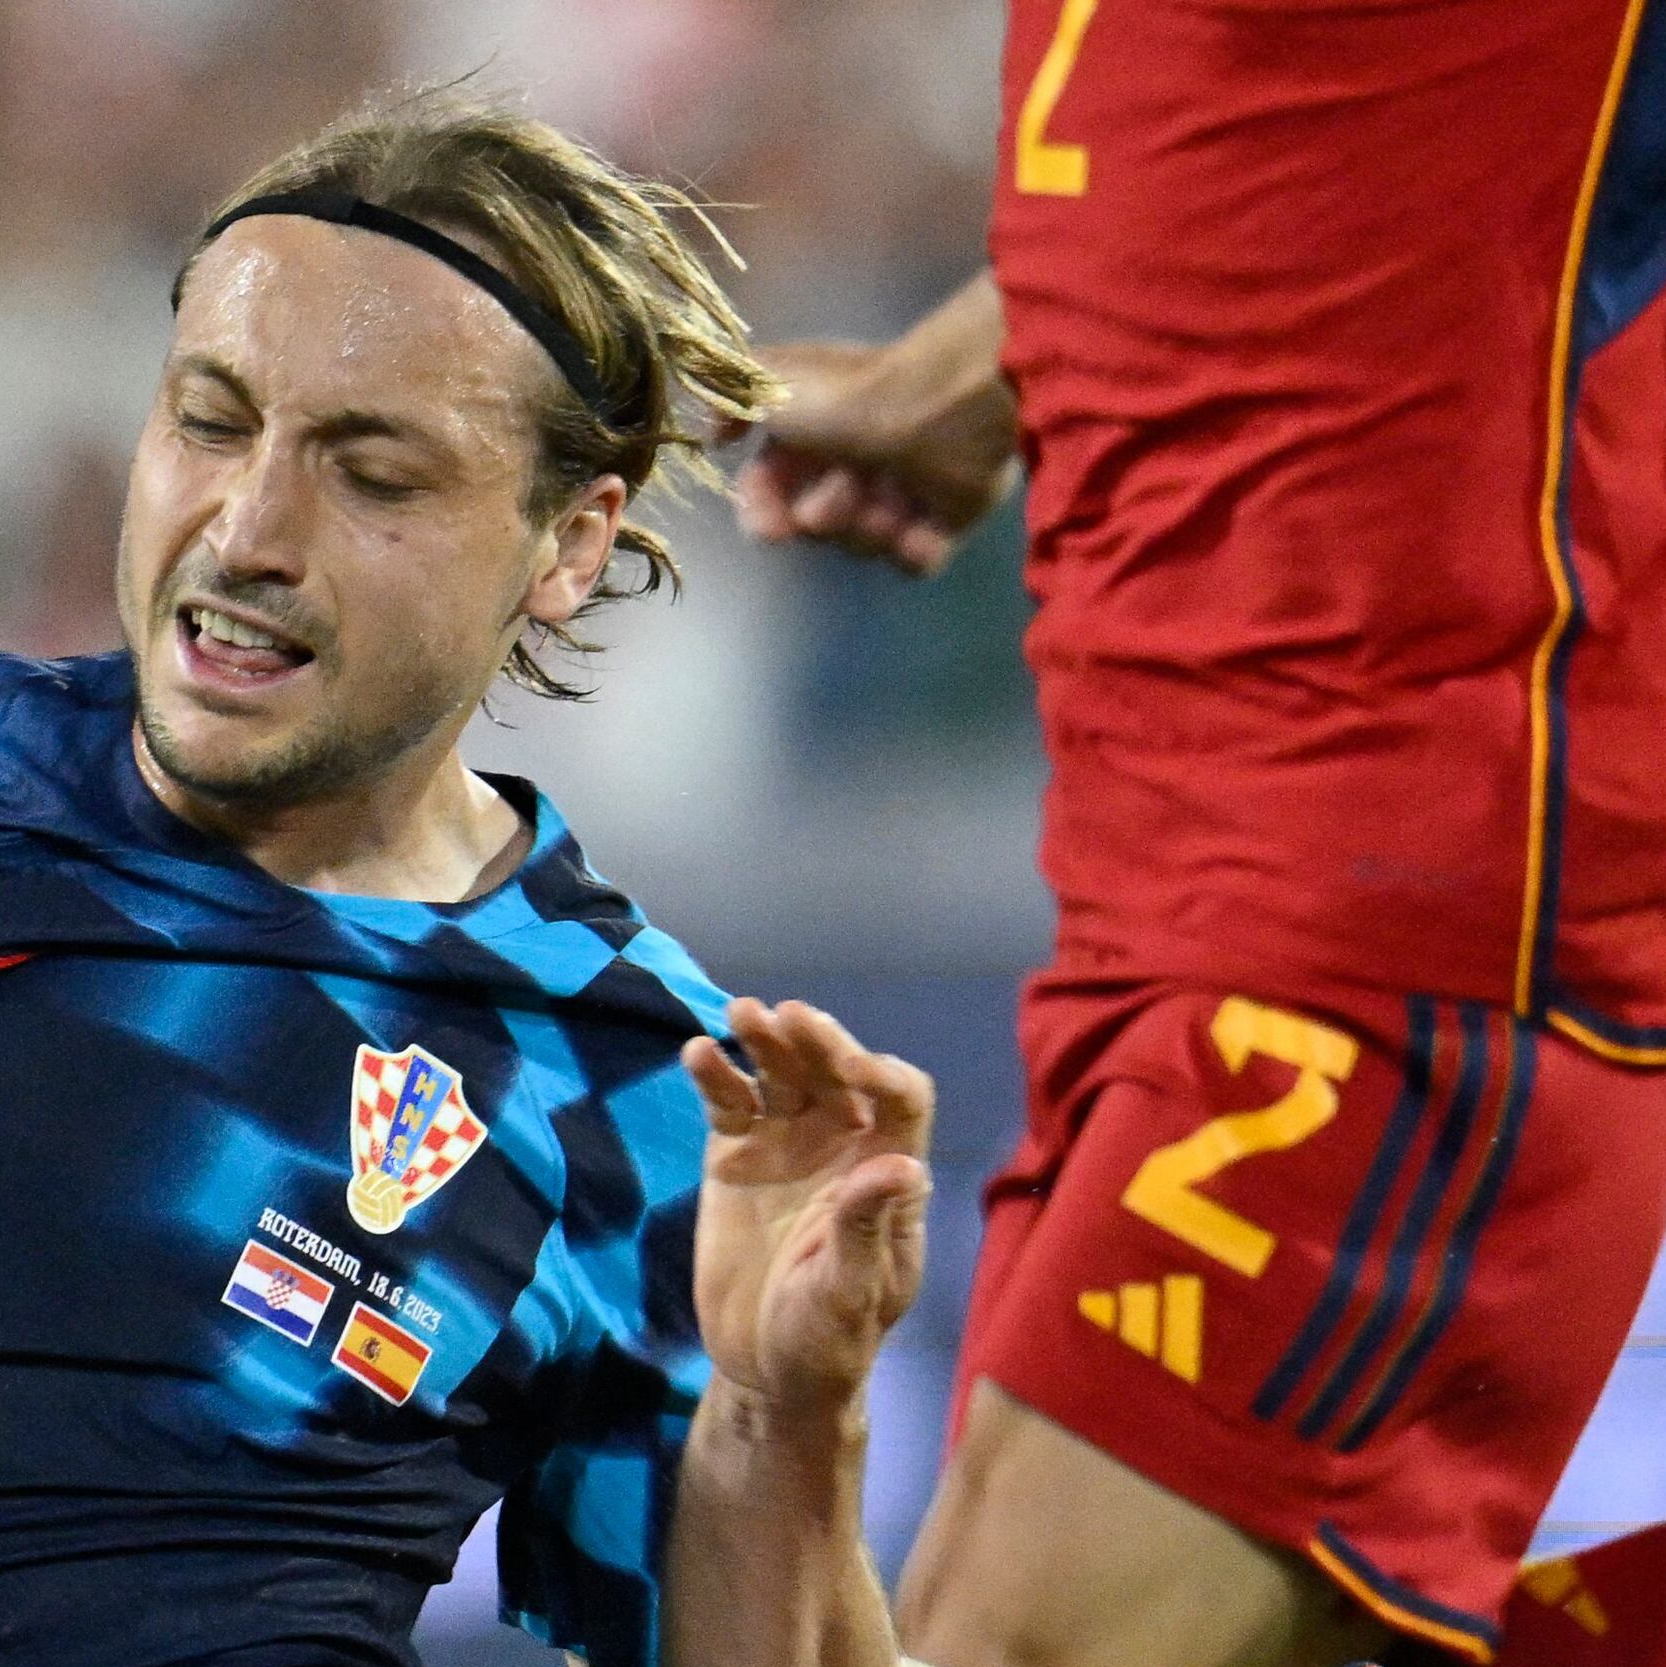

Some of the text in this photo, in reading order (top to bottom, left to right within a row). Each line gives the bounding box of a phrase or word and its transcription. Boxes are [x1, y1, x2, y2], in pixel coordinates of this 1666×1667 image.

[391, 1071, 438, 1160] HNS
[1119, 995, 1360, 1279] 2
[258, 1207, 361, 1286] ROTERDAM,
